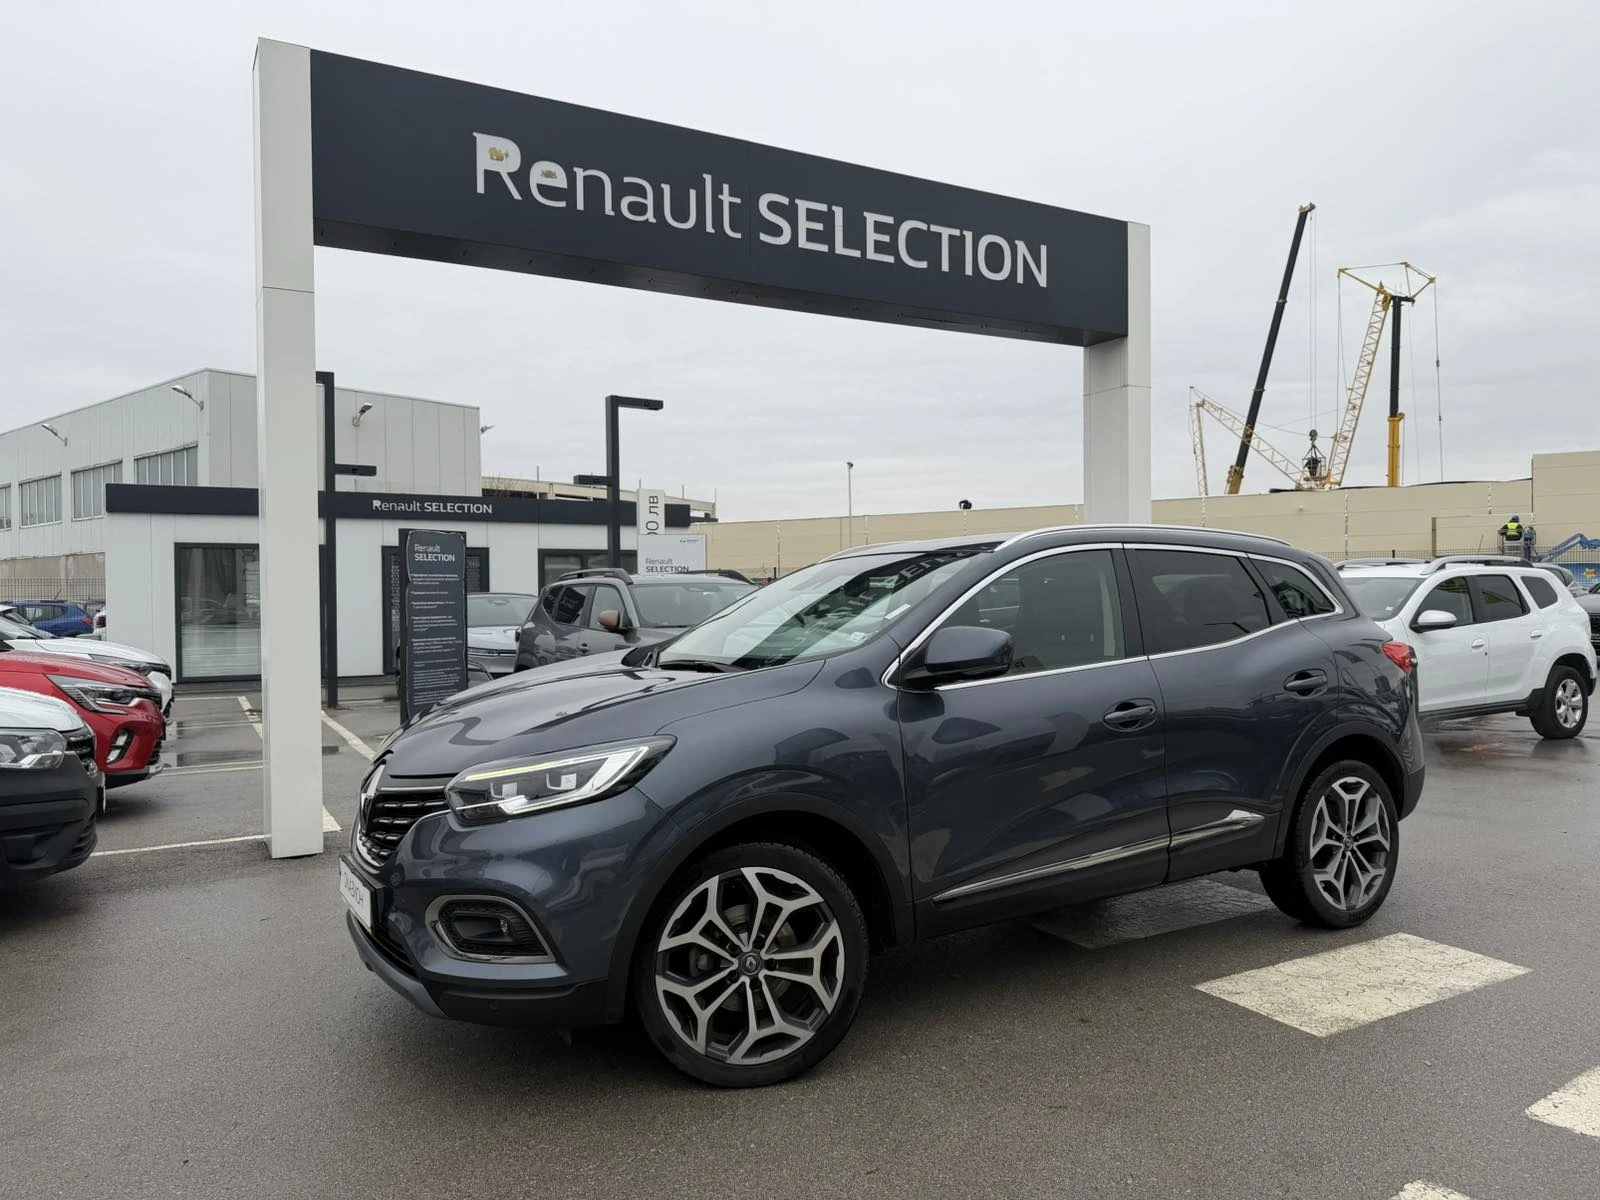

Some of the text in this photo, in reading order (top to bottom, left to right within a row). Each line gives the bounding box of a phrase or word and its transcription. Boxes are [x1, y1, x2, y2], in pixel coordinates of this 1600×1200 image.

[473, 132, 1048, 288] Renault SELECTION
[372, 499, 493, 514] Renault SELECTION
[414, 543, 441, 553] Renault
[414, 553, 456, 562] SELECTION
[645, 557, 673, 565] Renault
[645, 565, 690, 573] SELECTION
